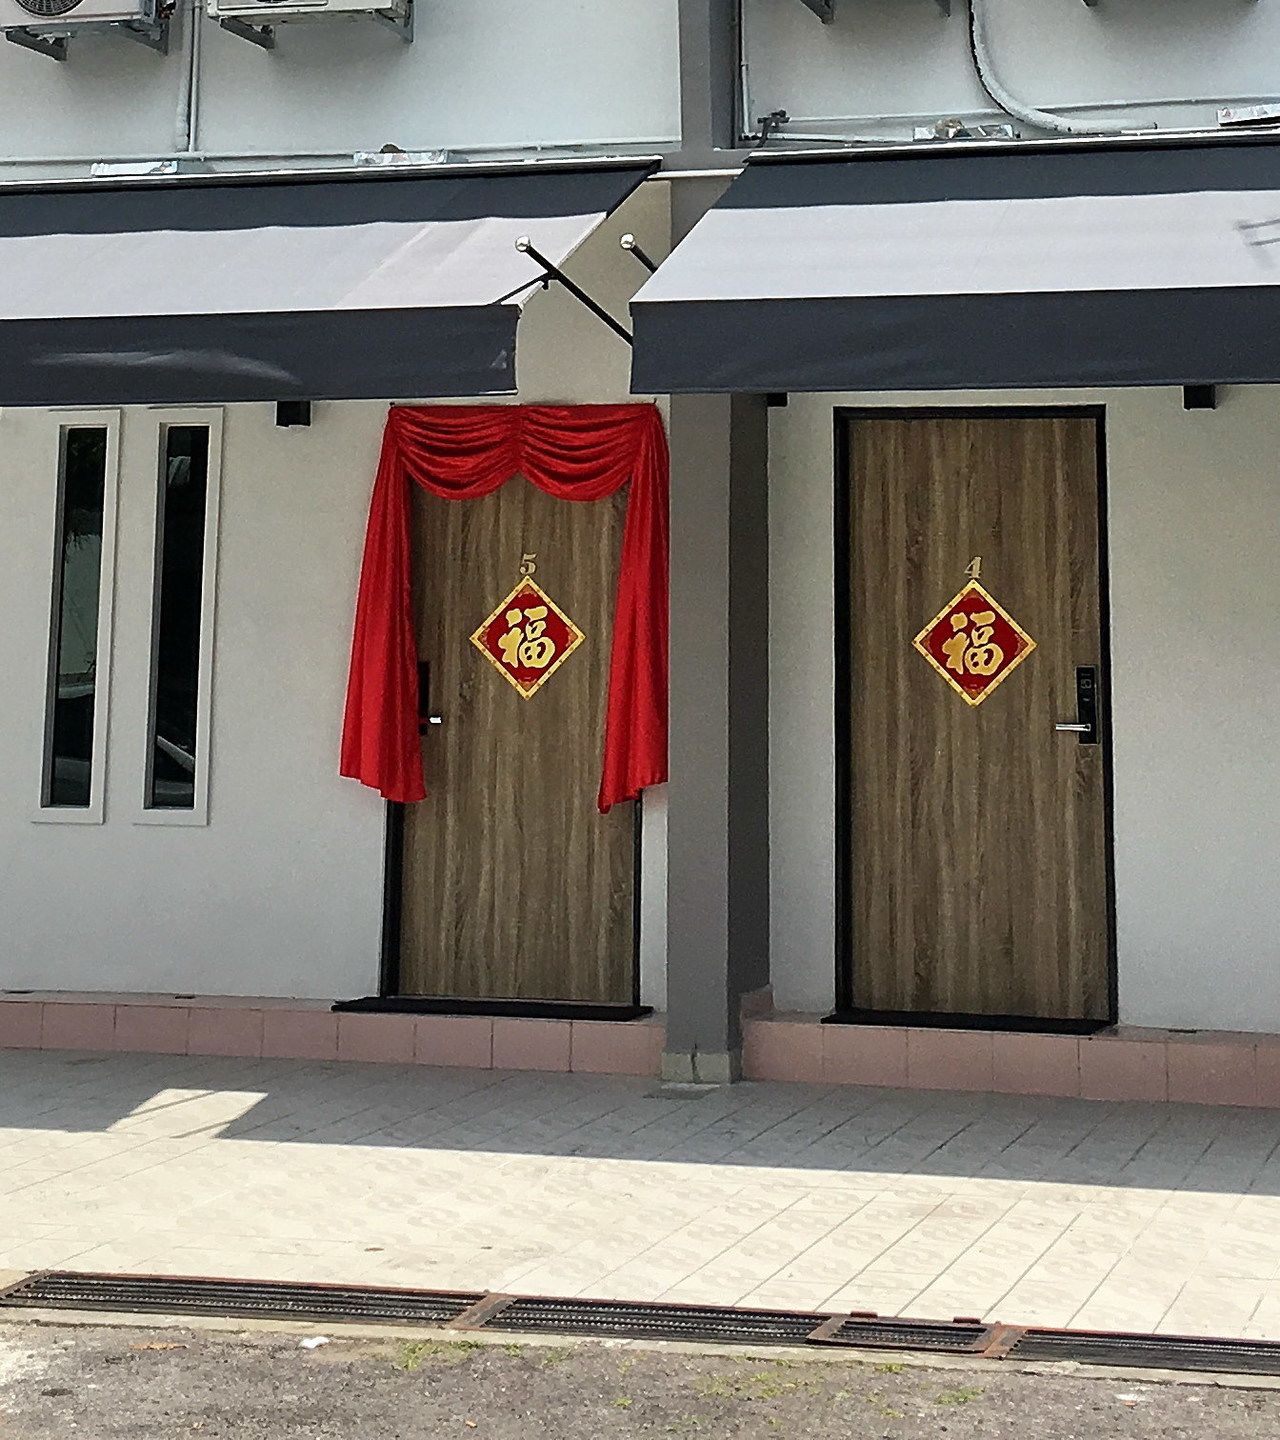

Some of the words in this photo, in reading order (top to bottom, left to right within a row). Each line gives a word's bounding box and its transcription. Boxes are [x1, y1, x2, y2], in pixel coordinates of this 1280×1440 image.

[520, 553, 538, 575] 5
[964, 556, 982, 579] 4
[498, 606, 556, 669] 福
[942, 611, 1004, 676] 福
